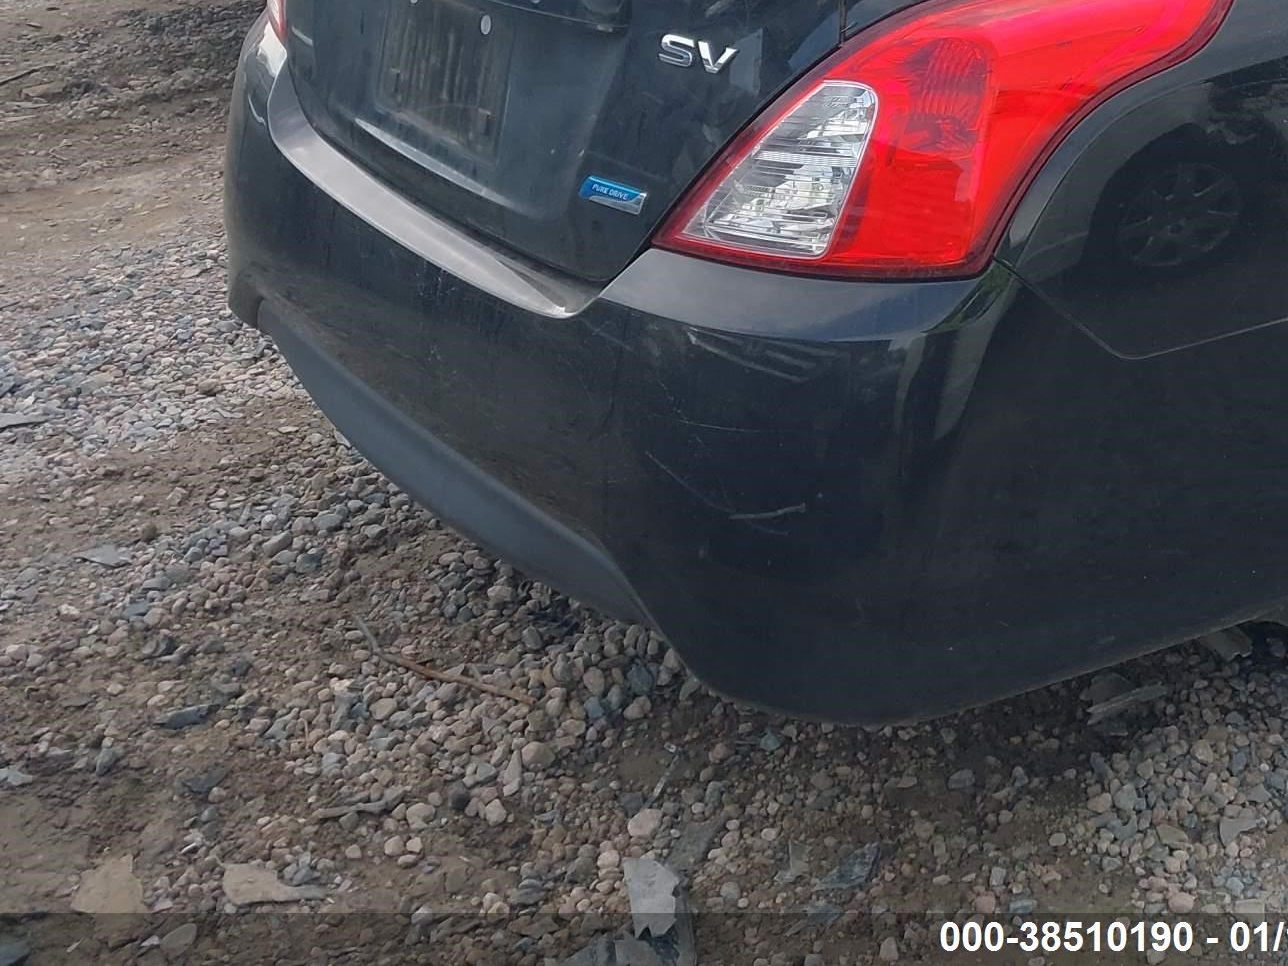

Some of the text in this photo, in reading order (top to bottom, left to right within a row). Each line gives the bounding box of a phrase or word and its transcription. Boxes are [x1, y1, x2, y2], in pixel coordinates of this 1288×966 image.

[657, 33, 739, 74] SV
[591, 183, 629, 200] PURE DRIVE
